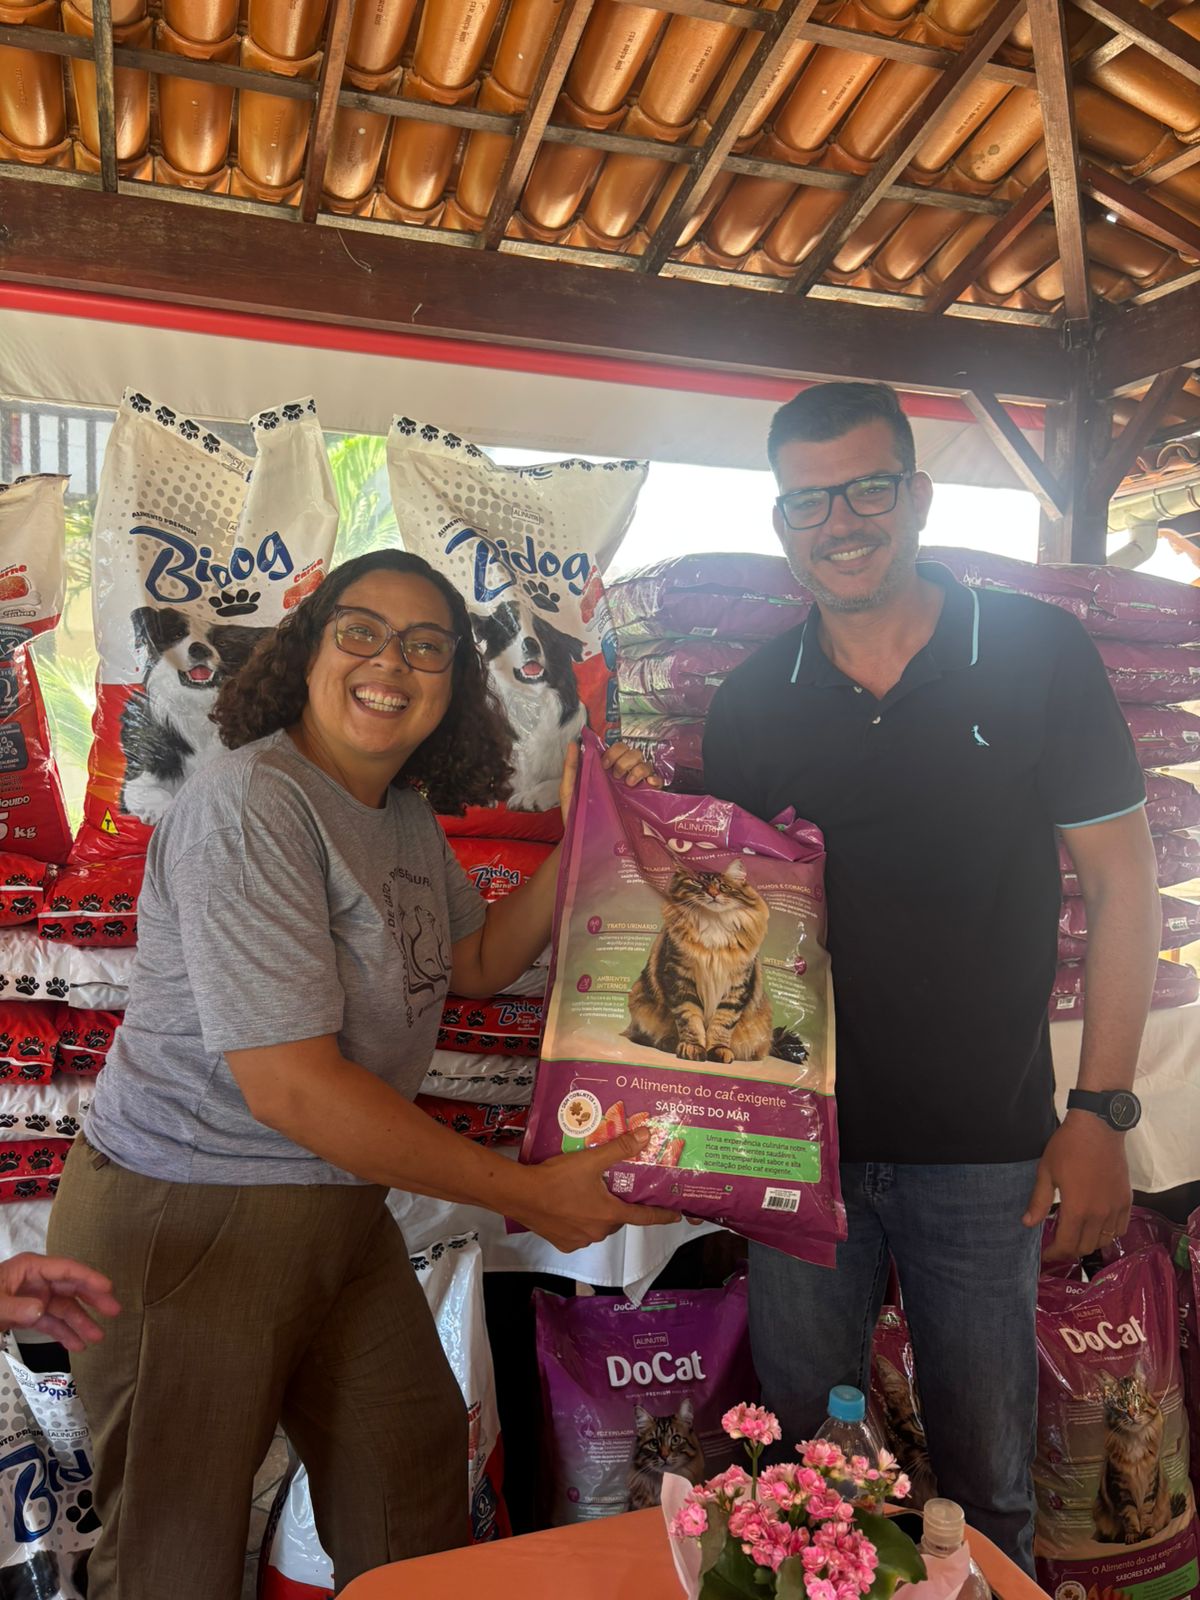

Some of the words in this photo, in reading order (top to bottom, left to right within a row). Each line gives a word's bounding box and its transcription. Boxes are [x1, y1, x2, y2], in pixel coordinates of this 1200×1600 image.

[13, 826, 37, 839] kg
[468, 864, 521, 890] Bidog
[616, 1075, 628, 1088] O
[630, 1077, 692, 1096] Alimento
[694, 1085, 712, 1098] do
[714, 1088, 735, 1101] cat
[736, 1092, 788, 1109] exigente
[655, 1100, 706, 1117] SABORES
[707, 1106, 725, 1119] DO
[726, 1109, 751, 1122] MAR
[703, 1160, 737, 1170] aceitação
[736, 1162, 753, 1172] pelo
[752, 1164, 764, 1172] cat
[704, 1152, 720, 1160] com
[1058, 1315, 1148, 1354] DoCat
[606, 1350, 707, 1388] DoCat
[1091, 1566, 1100, 1576] O
[1101, 1559, 1136, 1573] Alimento
[1135, 1556, 1147, 1566] do
